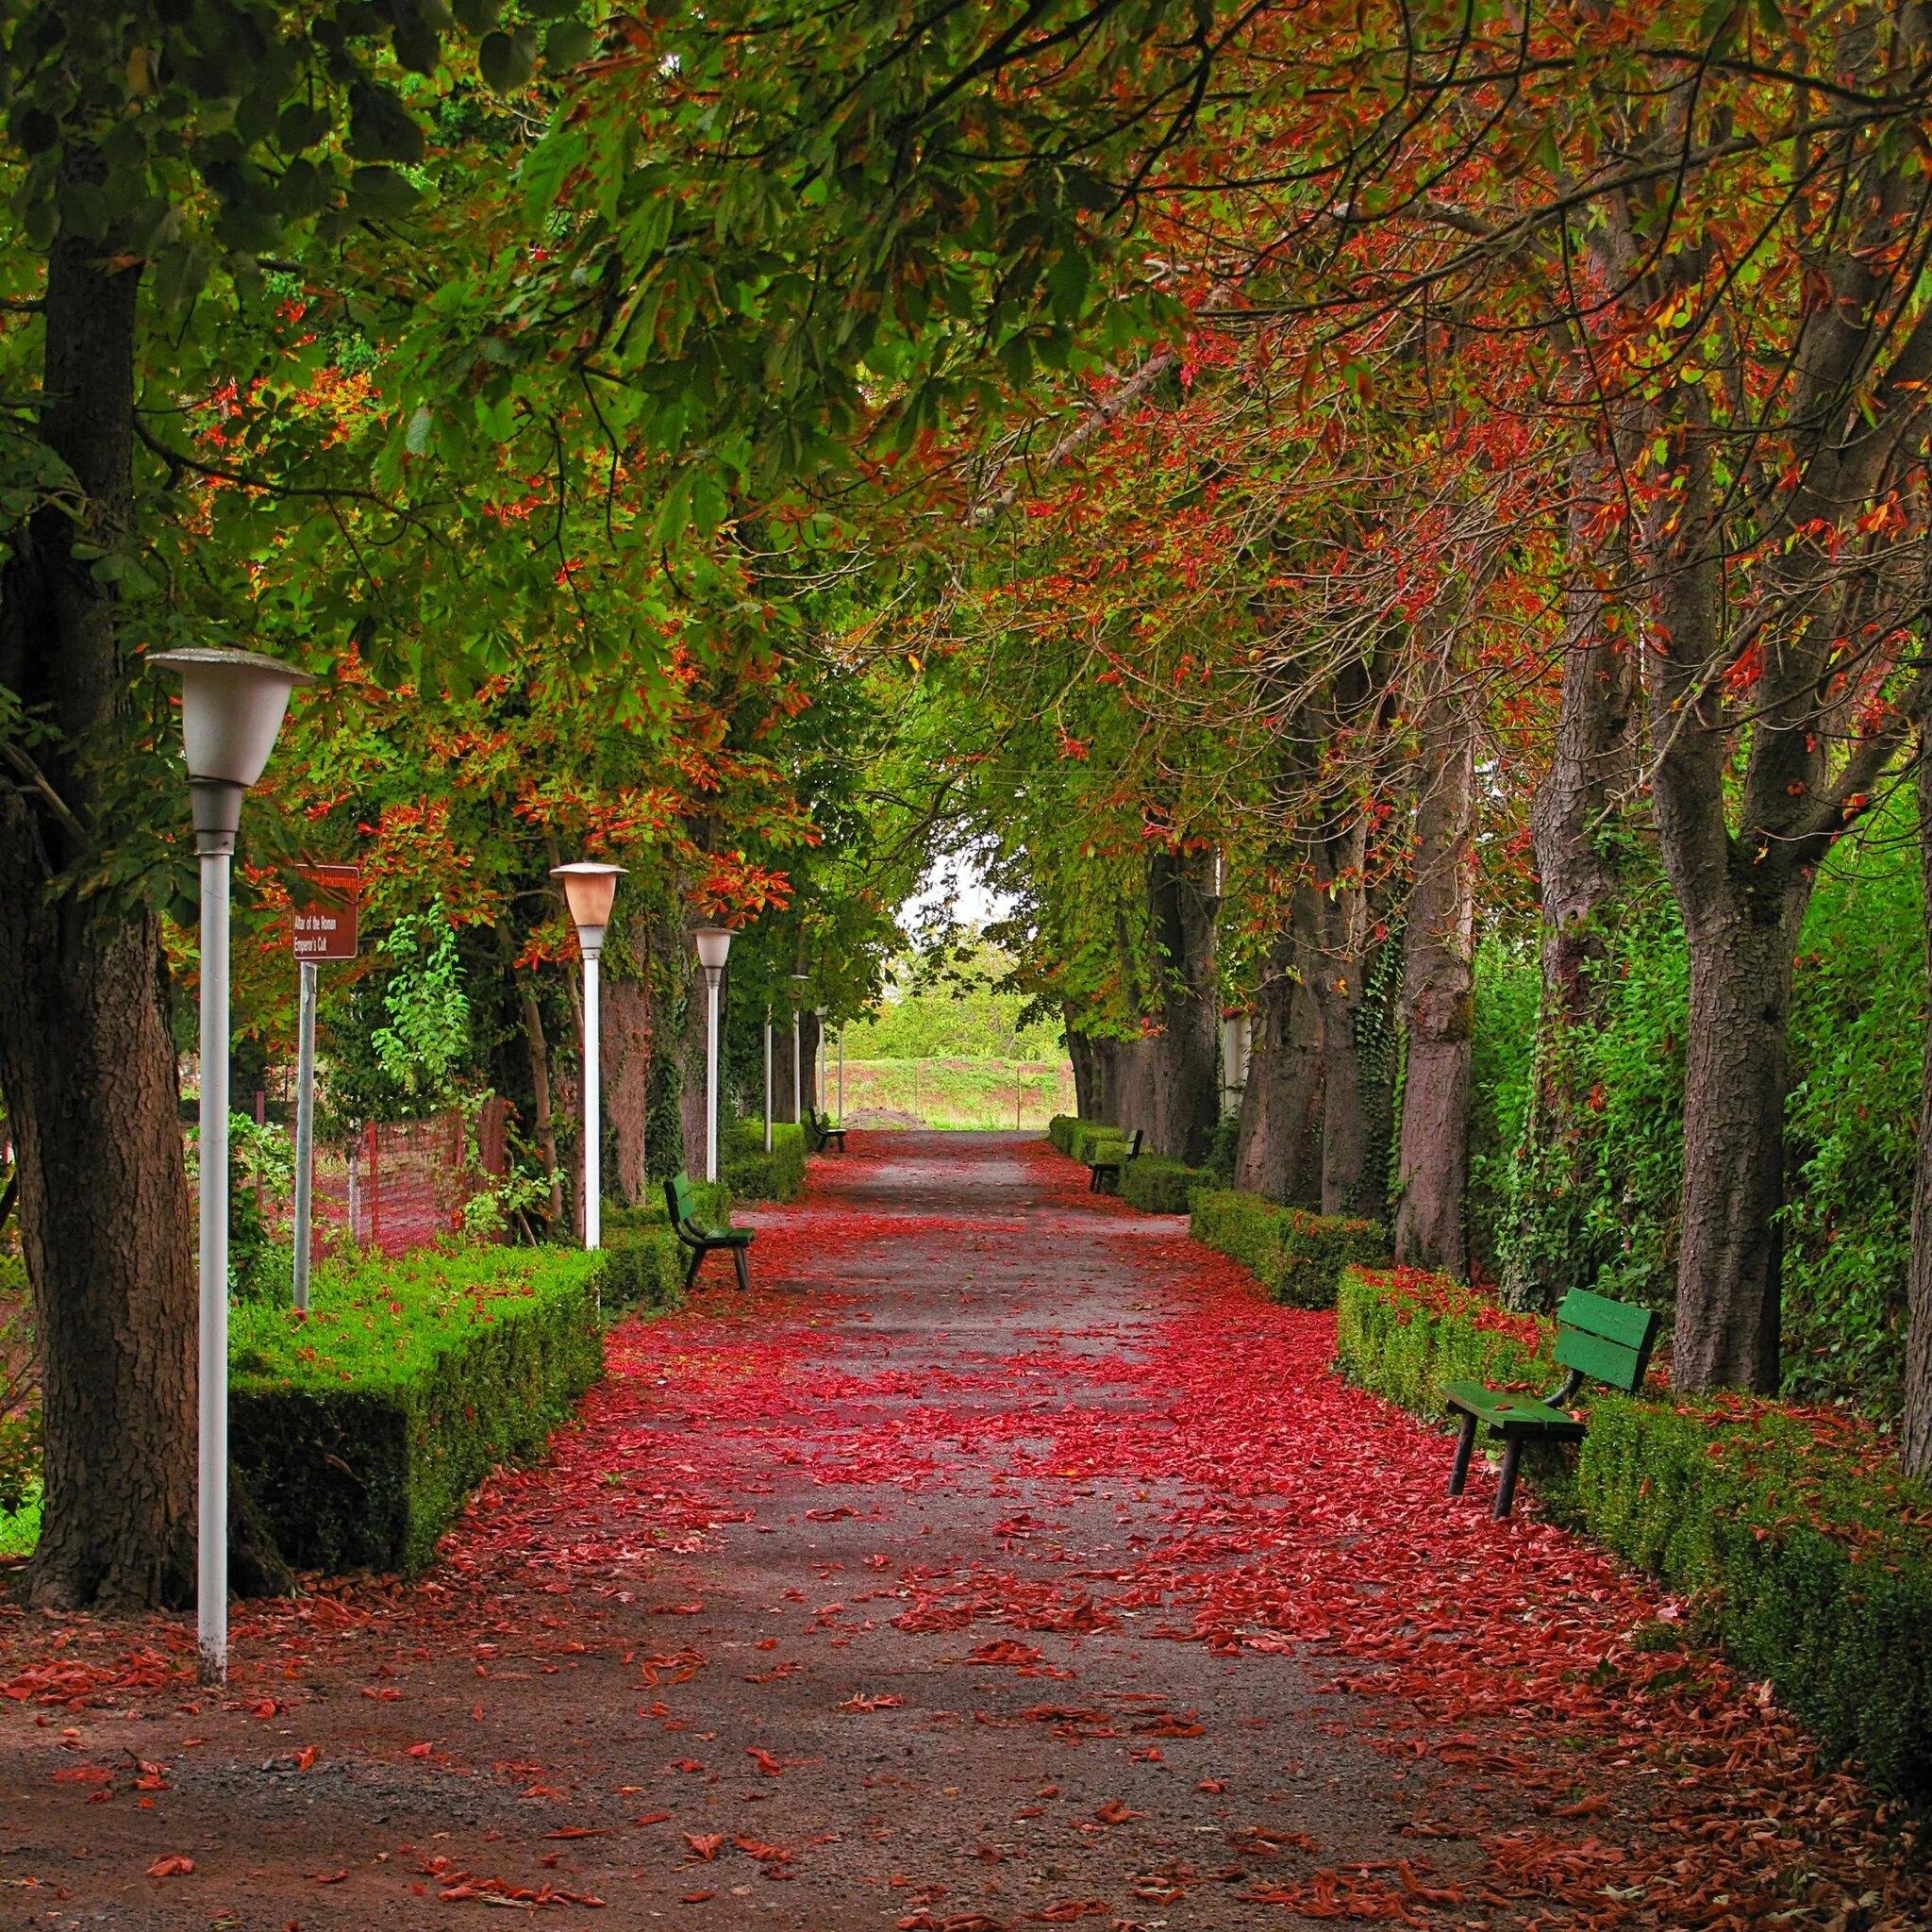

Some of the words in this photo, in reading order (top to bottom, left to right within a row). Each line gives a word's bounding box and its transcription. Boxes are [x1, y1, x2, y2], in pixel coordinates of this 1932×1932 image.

[294, 915, 305, 930] Altar
[306, 915, 312, 930] of
[312, 915, 321, 930] the
[321, 915, 336, 930] Roman
[294, 937, 316, 955] Emperor's
[317, 937, 327, 952] Cult
